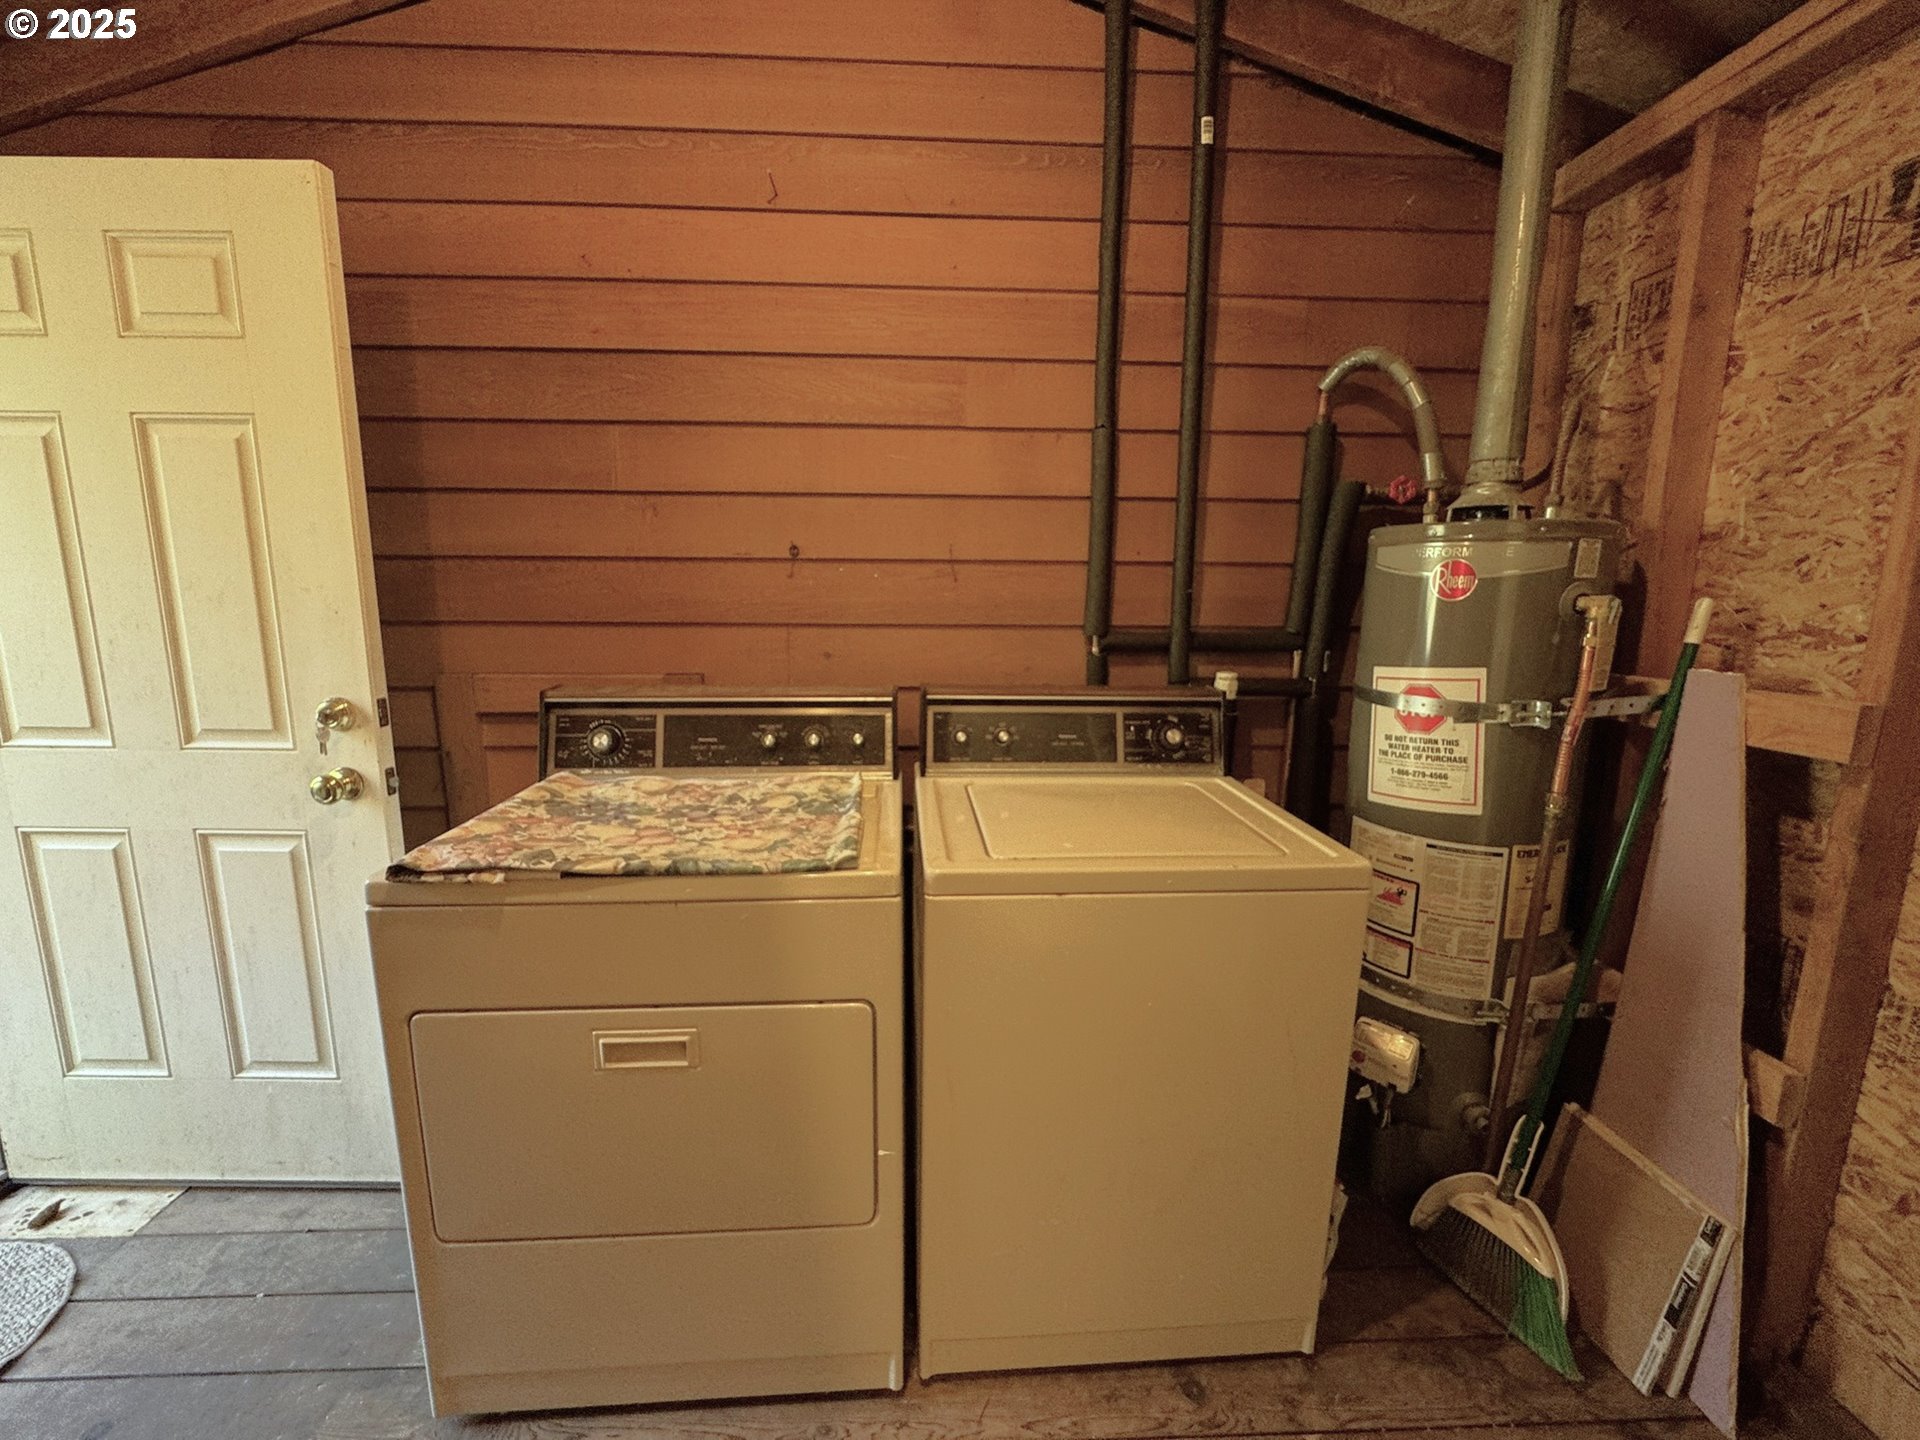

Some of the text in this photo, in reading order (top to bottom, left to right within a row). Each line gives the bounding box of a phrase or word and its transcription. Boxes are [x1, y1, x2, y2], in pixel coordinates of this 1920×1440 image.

[1435, 561, 1476, 594] Rheem
[1384, 733, 1459, 747] DO NOT RETURN THIS
[1378, 748, 1468, 764] THE PLACE OF PURCHASE
[1388, 742, 1453, 755] WATER HEATER TO
